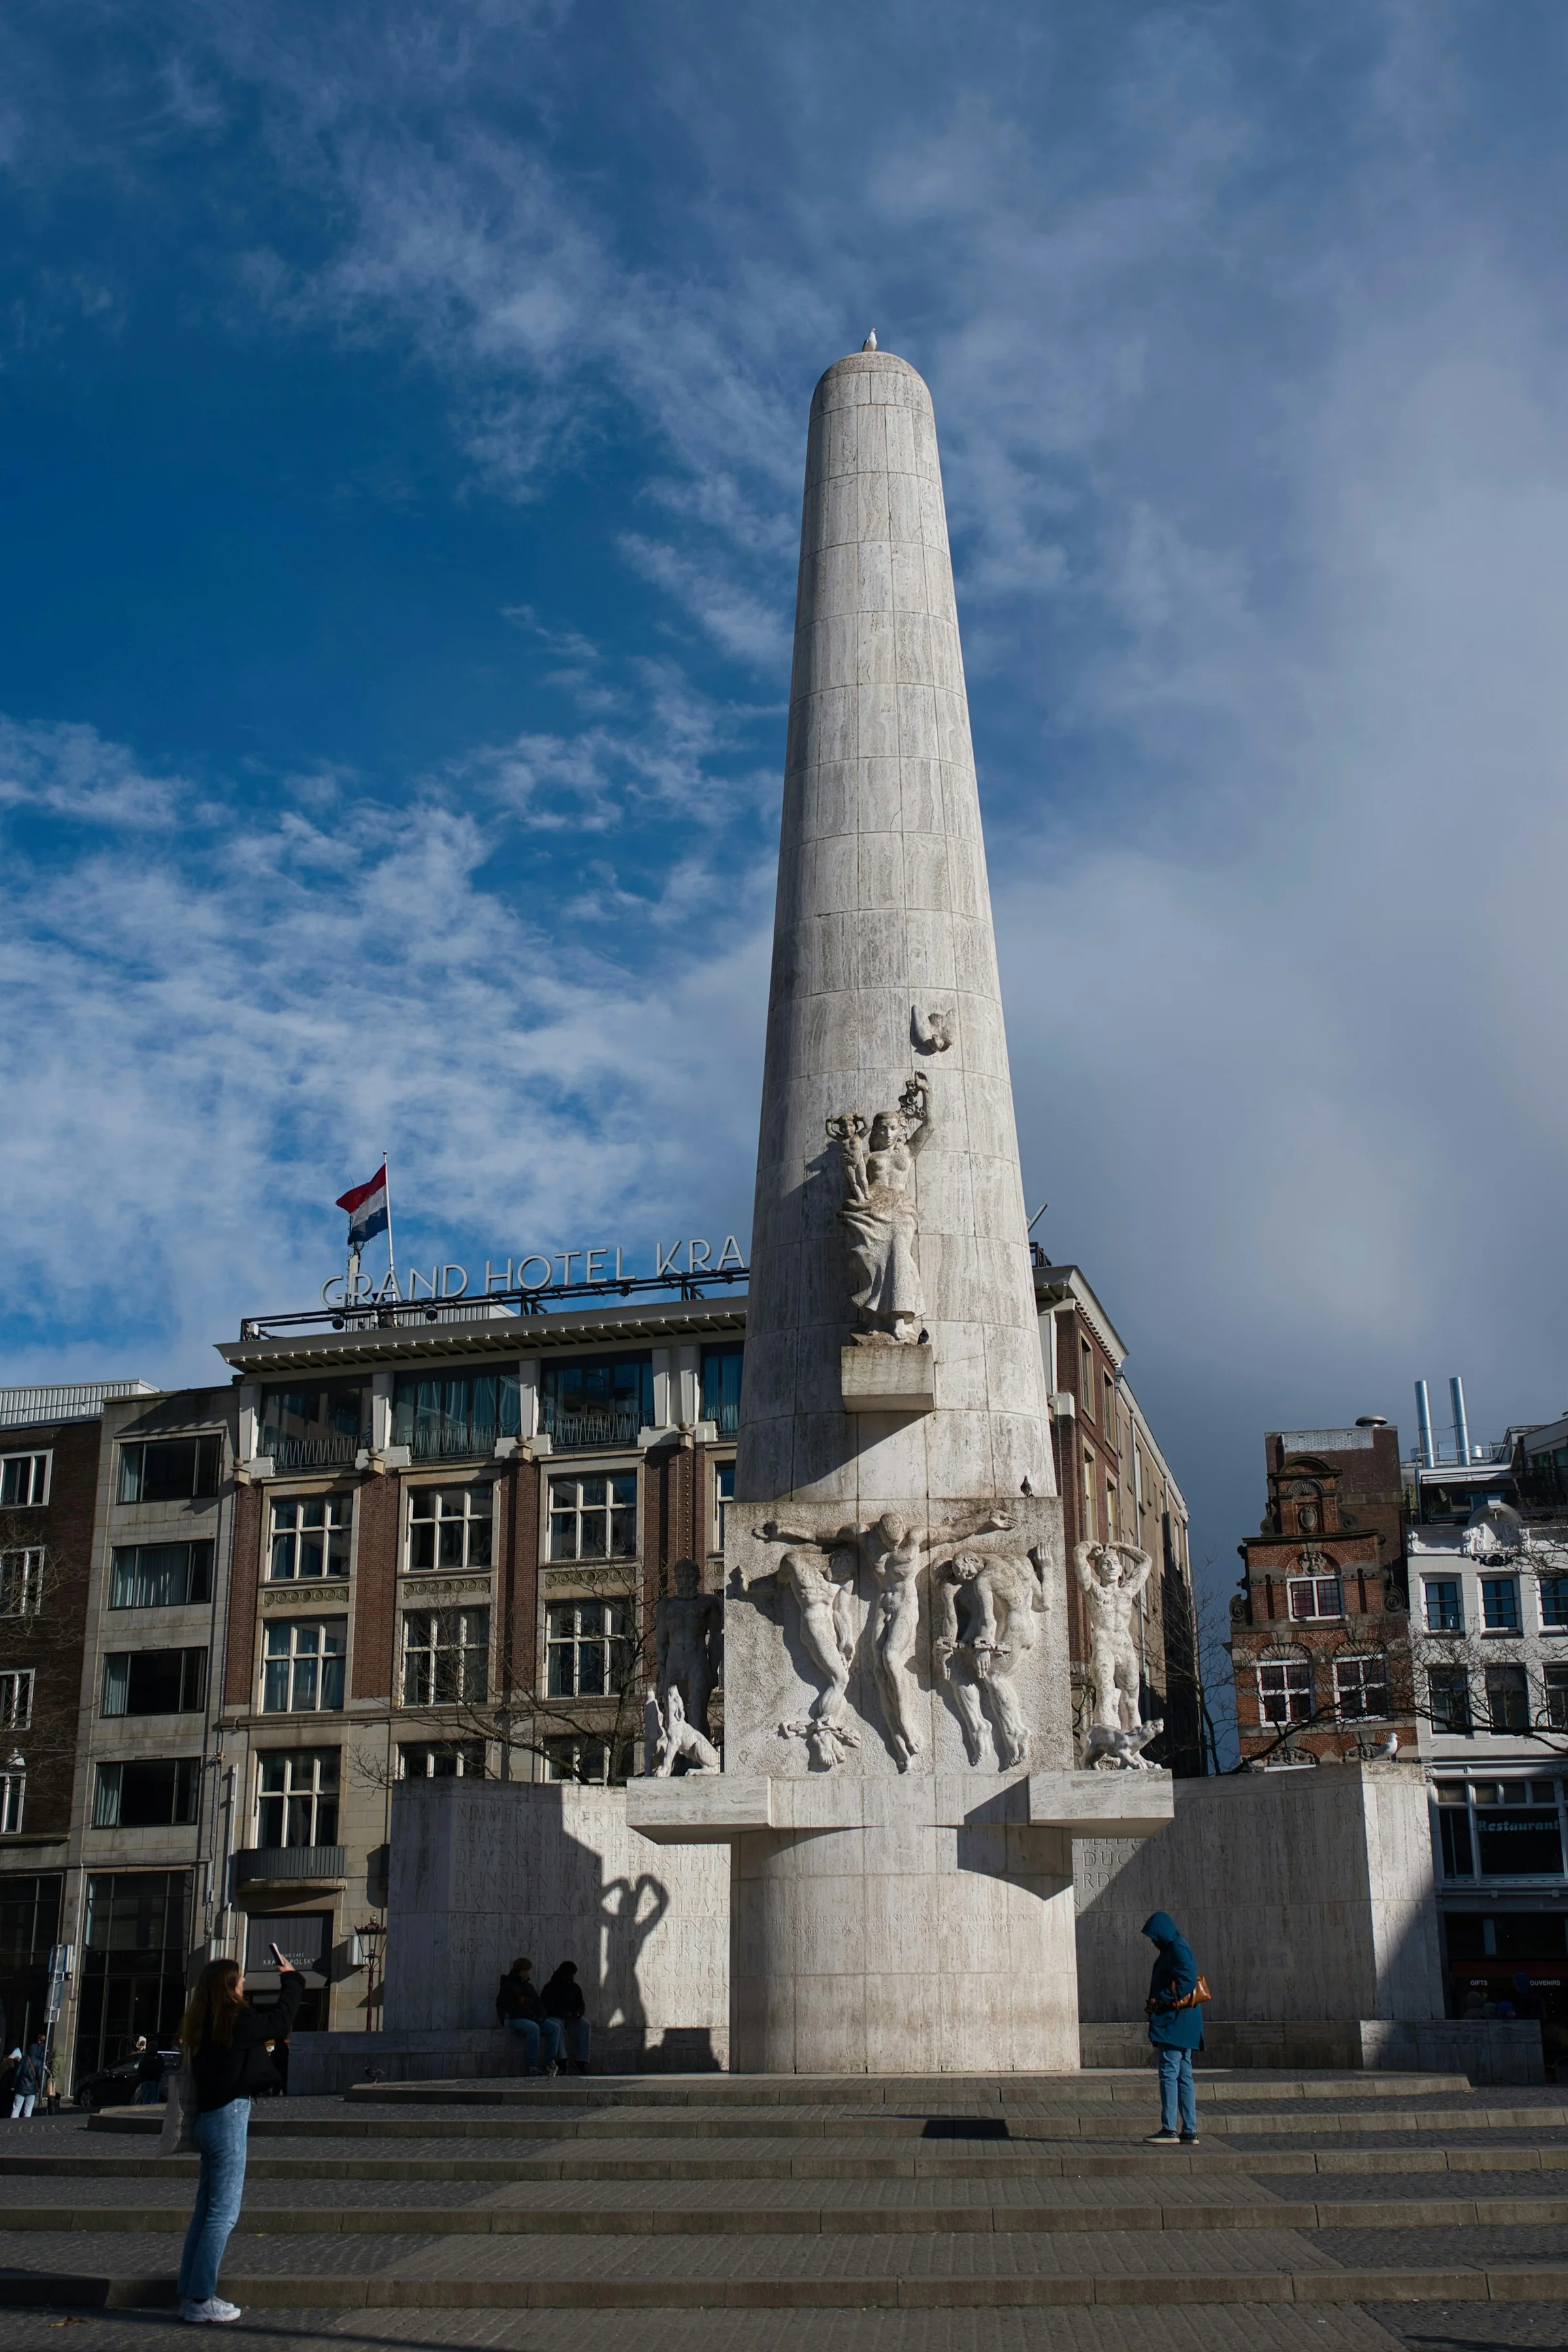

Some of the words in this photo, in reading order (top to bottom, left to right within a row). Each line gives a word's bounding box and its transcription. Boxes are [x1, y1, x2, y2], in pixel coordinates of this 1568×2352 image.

[320, 1264, 470, 1308] GRAND
[485, 1247, 636, 1294] HOTEL
[655, 1234, 747, 1277] KRA
[456, 1804, 523, 1824] NIMMER
[1477, 1820, 1560, 1831] Restaurant
[515, 1830, 568, 1848] NOCH
